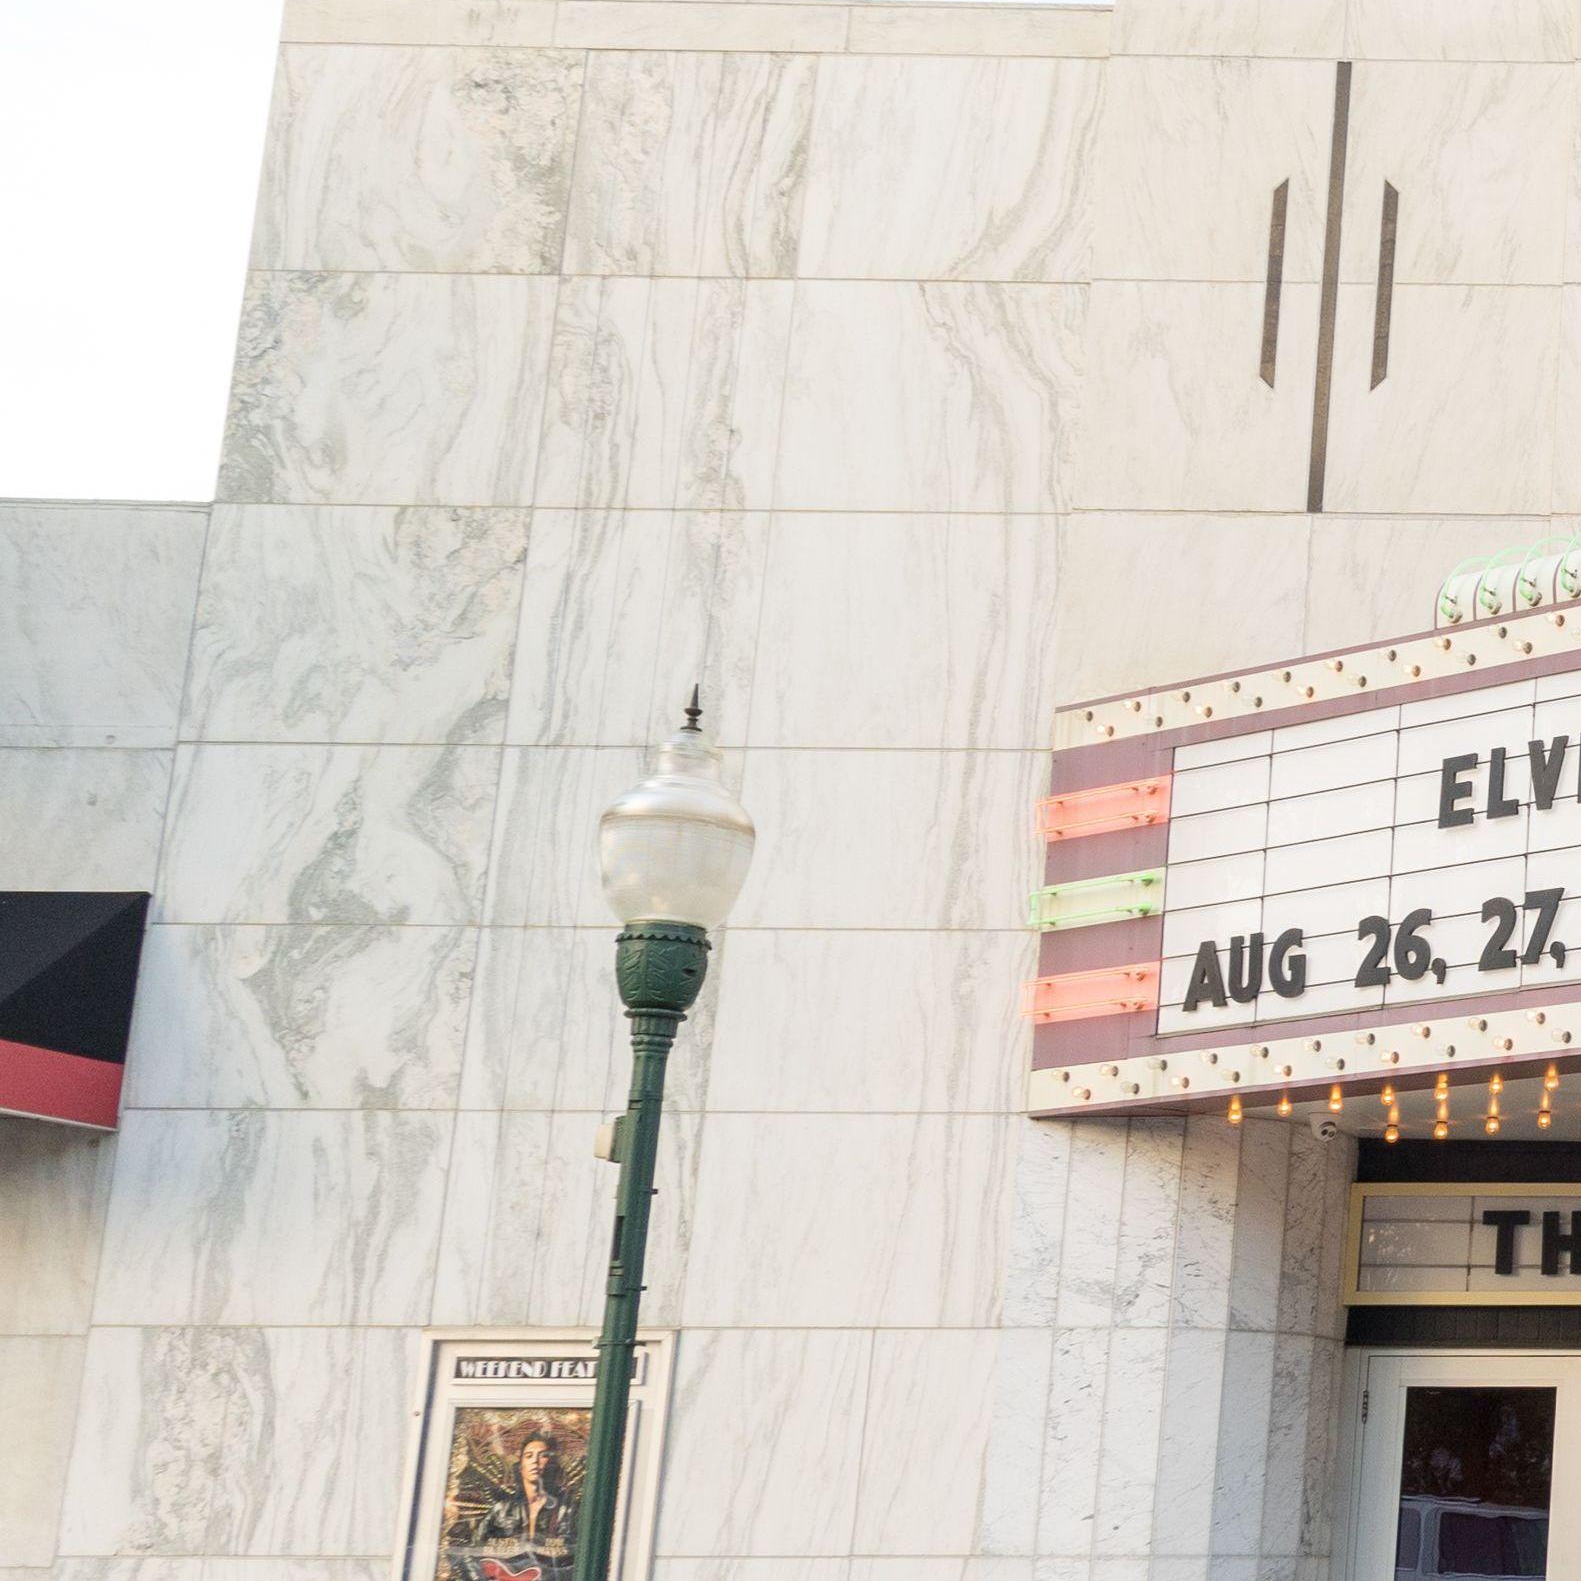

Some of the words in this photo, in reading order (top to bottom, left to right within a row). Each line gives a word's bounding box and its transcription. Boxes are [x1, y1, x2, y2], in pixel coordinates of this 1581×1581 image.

[1182, 927, 1307, 1013] AUG
[1354, 907, 1447, 988] 26,
[1478, 887, 1567, 972] 27,
[459, 1361, 547, 1379] WEEKEND
